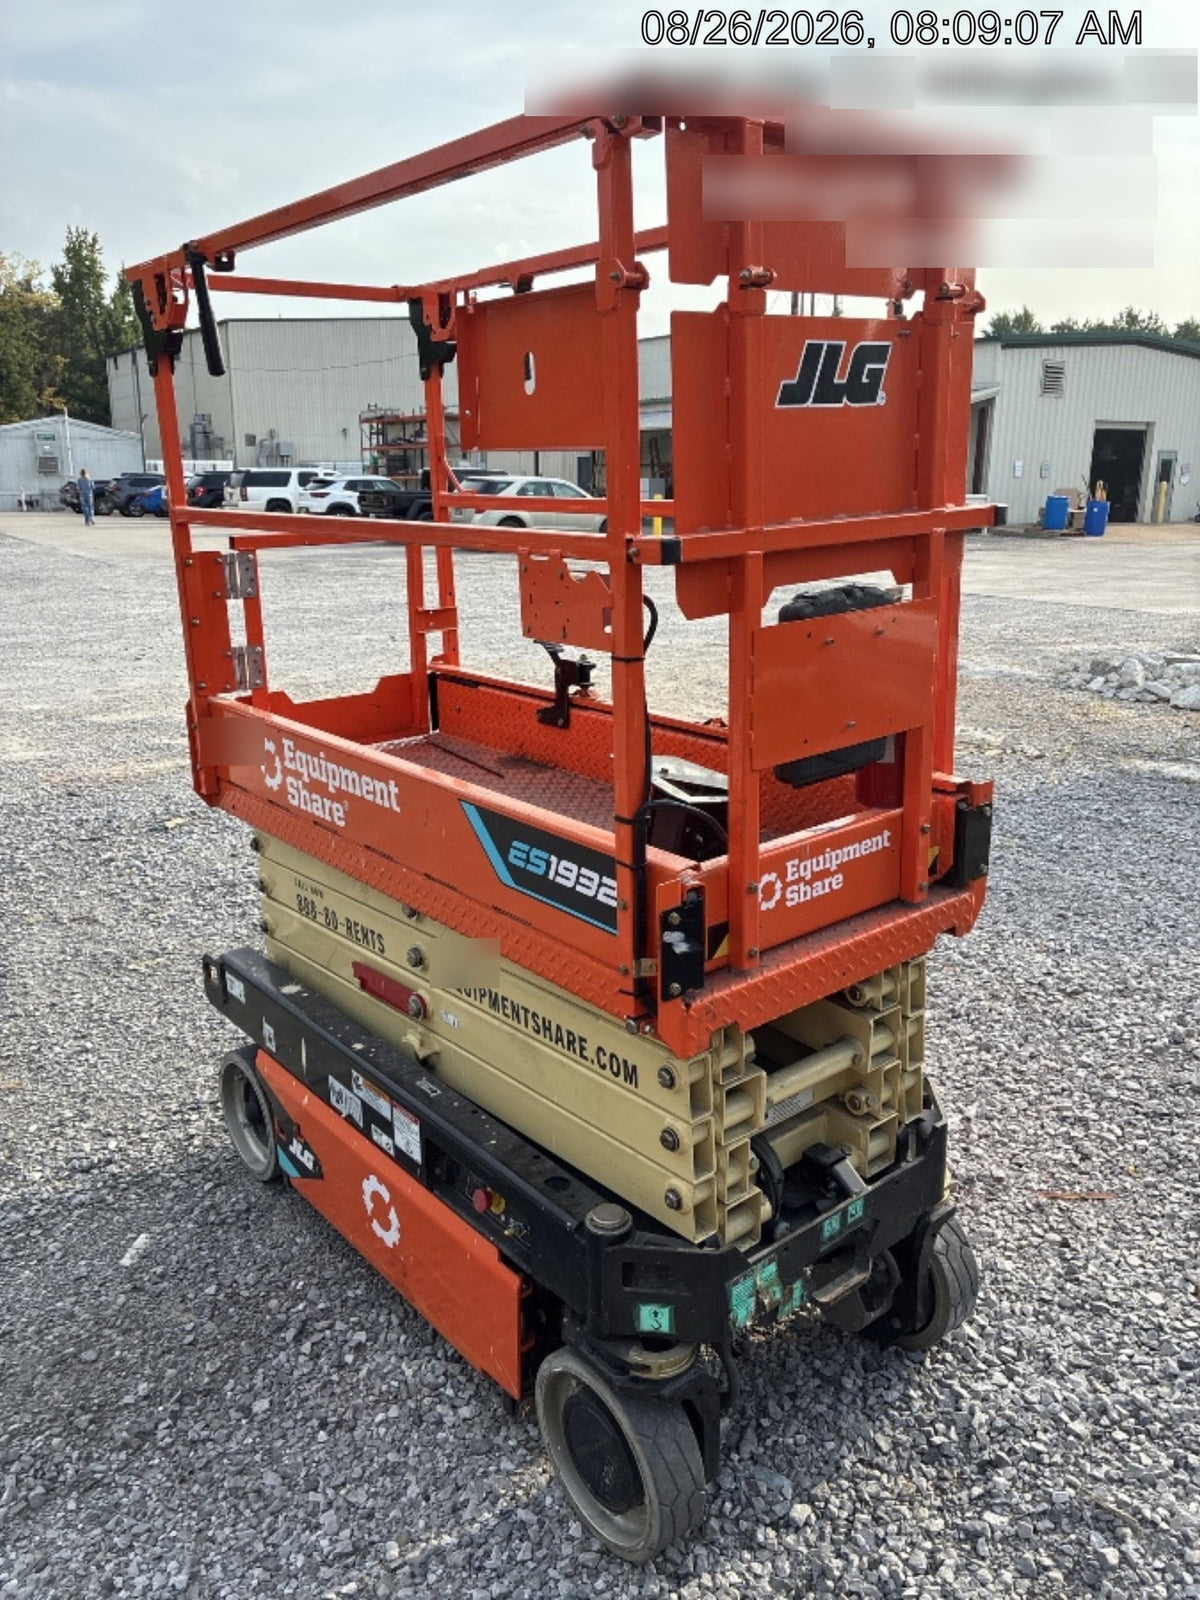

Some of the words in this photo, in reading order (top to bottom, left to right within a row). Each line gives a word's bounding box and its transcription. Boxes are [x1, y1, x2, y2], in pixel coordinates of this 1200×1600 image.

[776, 340, 893, 408] JLG
[282, 737, 401, 813] Equipment
[286, 775, 345, 827] Share
[508, 840, 618, 908] ES1932
[785, 829, 891, 882] Equipment
[785, 872, 844, 908] Share
[289, 1137, 315, 1171] JLG
